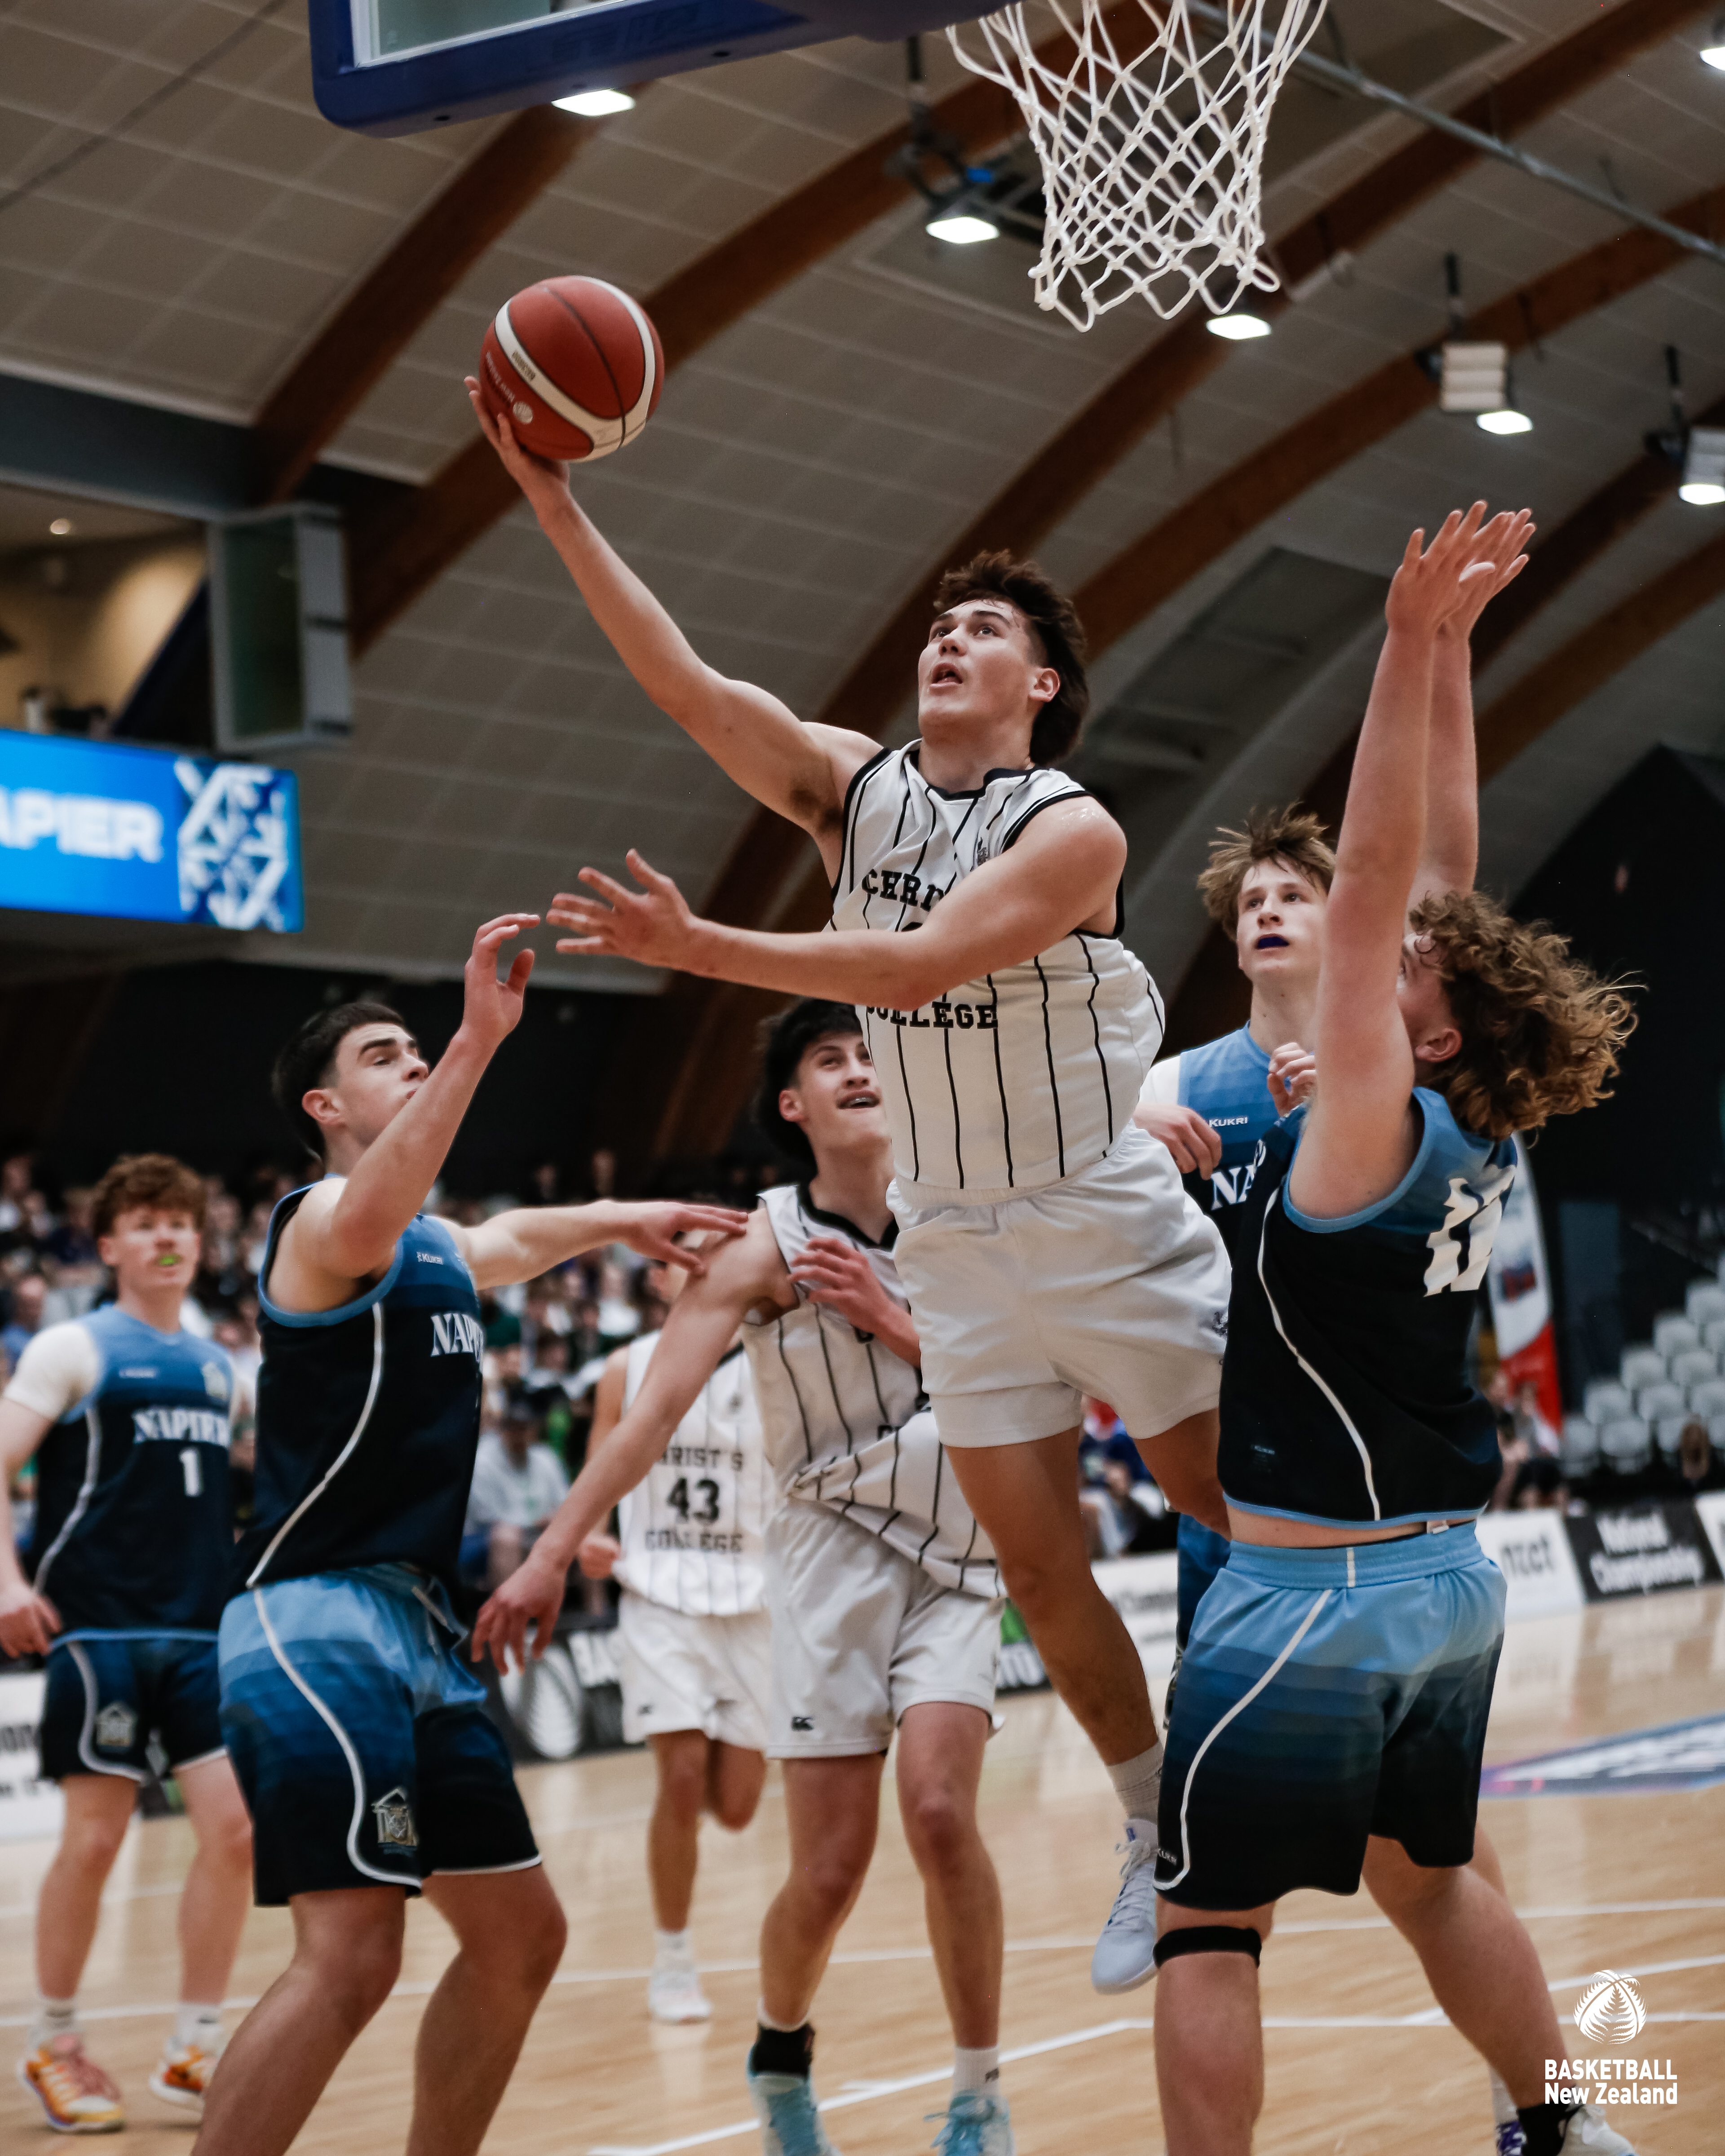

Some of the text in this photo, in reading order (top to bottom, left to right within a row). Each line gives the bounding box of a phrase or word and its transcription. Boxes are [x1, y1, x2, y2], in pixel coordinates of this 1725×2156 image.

[1210, 1117, 1249, 1128] KUKRI
[181, 1448, 202, 1497] 1
[667, 1478, 720, 1524] 43
